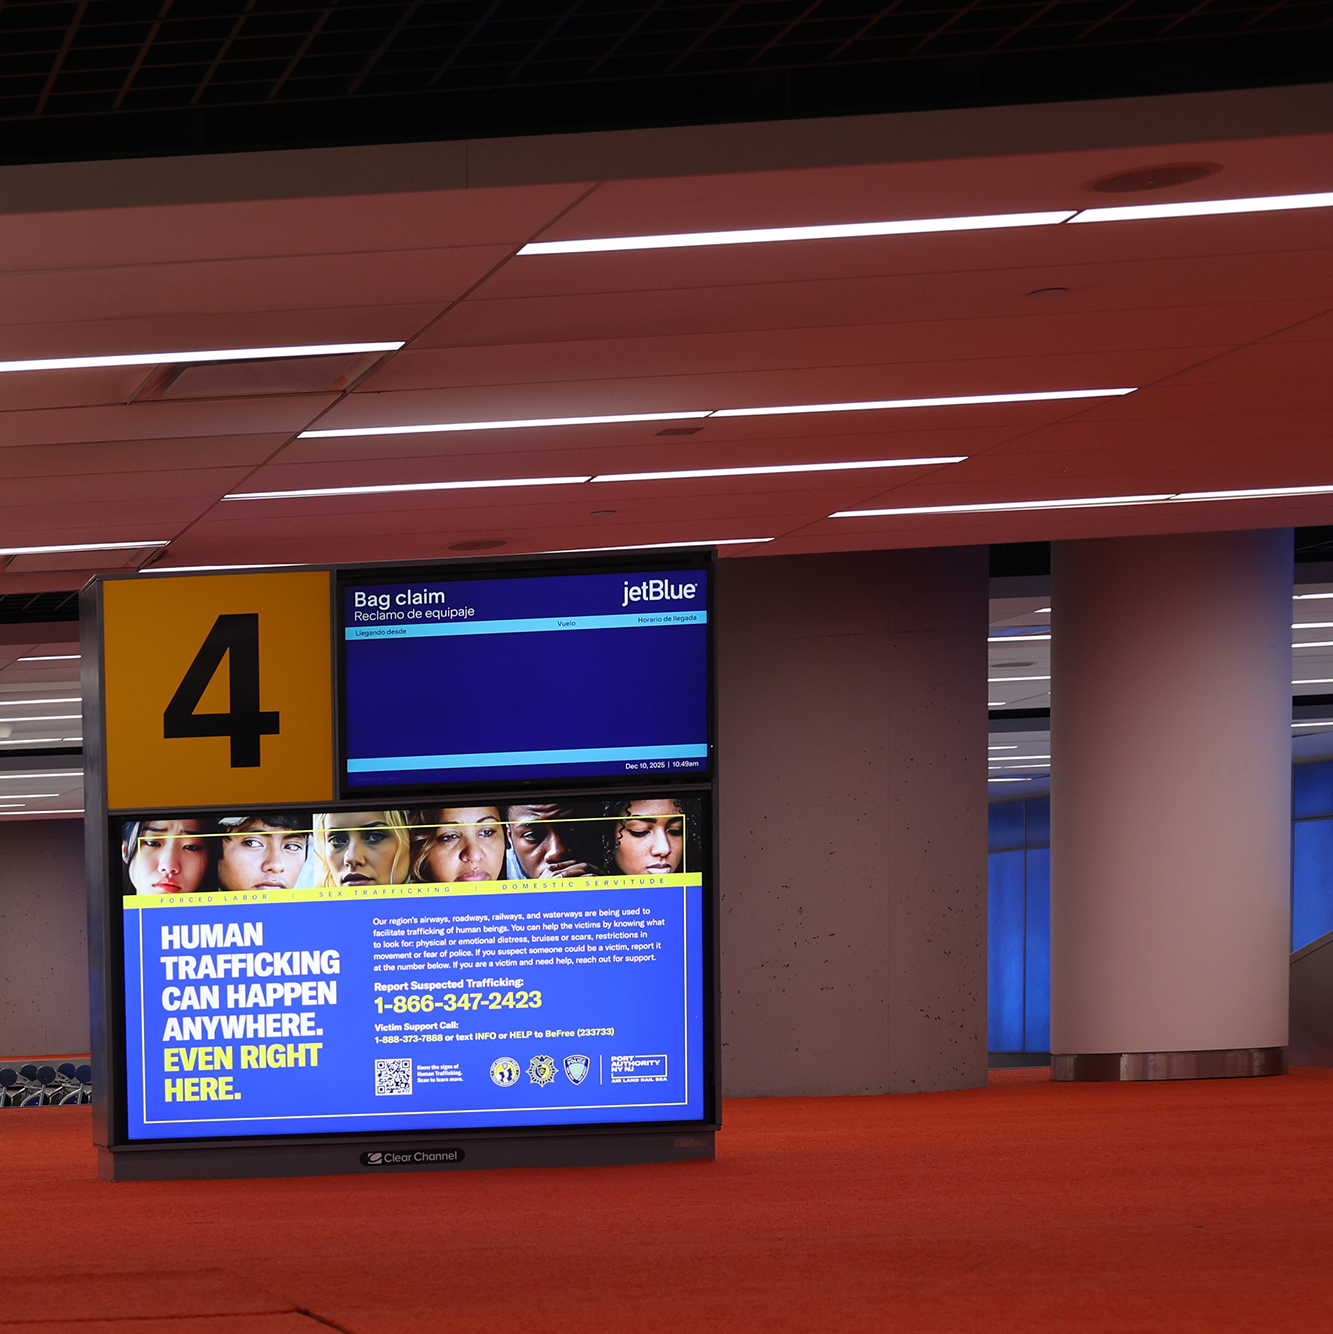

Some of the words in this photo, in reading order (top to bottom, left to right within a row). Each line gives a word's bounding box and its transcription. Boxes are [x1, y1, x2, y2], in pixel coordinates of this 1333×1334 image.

[354, 591, 390, 610] Bag
[395, 589, 445, 605] claim
[622, 579, 695, 607] jetBlue
[354, 610, 404, 622] Reclamo
[407, 609, 422, 619] de
[425, 606, 475, 620] equipaje
[673, 614, 698, 623] llegada
[355, 629, 385, 637] Llegando
[164, 613, 280, 768] 4
[640, 762, 649, 770] 10,
[649, 761, 665, 769] 2025
[160, 895, 213, 904] FORCED
[224, 893, 269, 902] LABOR
[319, 890, 342, 898] SEX
[354, 886, 450, 896] TRAFFICKING
[502, 881, 574, 890] DOMESTIC
[585, 878, 664, 887] SERVITUDE
[373, 917, 387, 925] Our
[389, 916, 418, 926] region's
[420, 916, 450, 924] airways,
[452, 914, 490, 923] roadways,
[492, 913, 524, 921] railways,
[543, 910, 582, 919] waterways
[599, 909, 620, 917] being
[622, 907, 640, 915] used
[161, 921, 263, 950] HUMAN
[373, 929, 405, 937] facilitate
[407, 927, 445, 936] trafficking
[455, 926, 481, 934] human
[483, 925, 509, 934] beings.
[511, 924, 525, 932] You
[542, 922, 559, 931] help
[574, 921, 601, 929] victims
[602, 920, 612, 929] by
[613, 920, 645, 928] knowing
[160, 949, 341, 980] TRAFFICKING
[161, 985, 219, 1011] CAN
[226, 980, 337, 1008] HAPPEN
[374, 982, 408, 993] Report
[410, 979, 464, 991] Suspected
[466, 977, 524, 989] Trafficking:
[374, 990, 543, 1014] 1-866-347-2423
[162, 1012, 324, 1041] ANYWHERE.
[374, 1023, 402, 1032] Victim
[403, 1022, 438, 1031] Support
[439, 1021, 459, 1030] Call:
[374, 1034, 443, 1044] 1-888-373-7888
[456, 1033, 473, 1041] text
[475, 1031, 497, 1040] INFO
[509, 1030, 532, 1039] HELP
[545, 1029, 575, 1038] BeFree
[577, 1028, 615, 1037] (233733)
[164, 1046, 233, 1072] EVEN
[240, 1043, 323, 1069] RIGHT
[164, 1077, 242, 1102] HERE.
[384, 1153, 412, 1163] Clear
[413, 1151, 457, 1162] Channel
